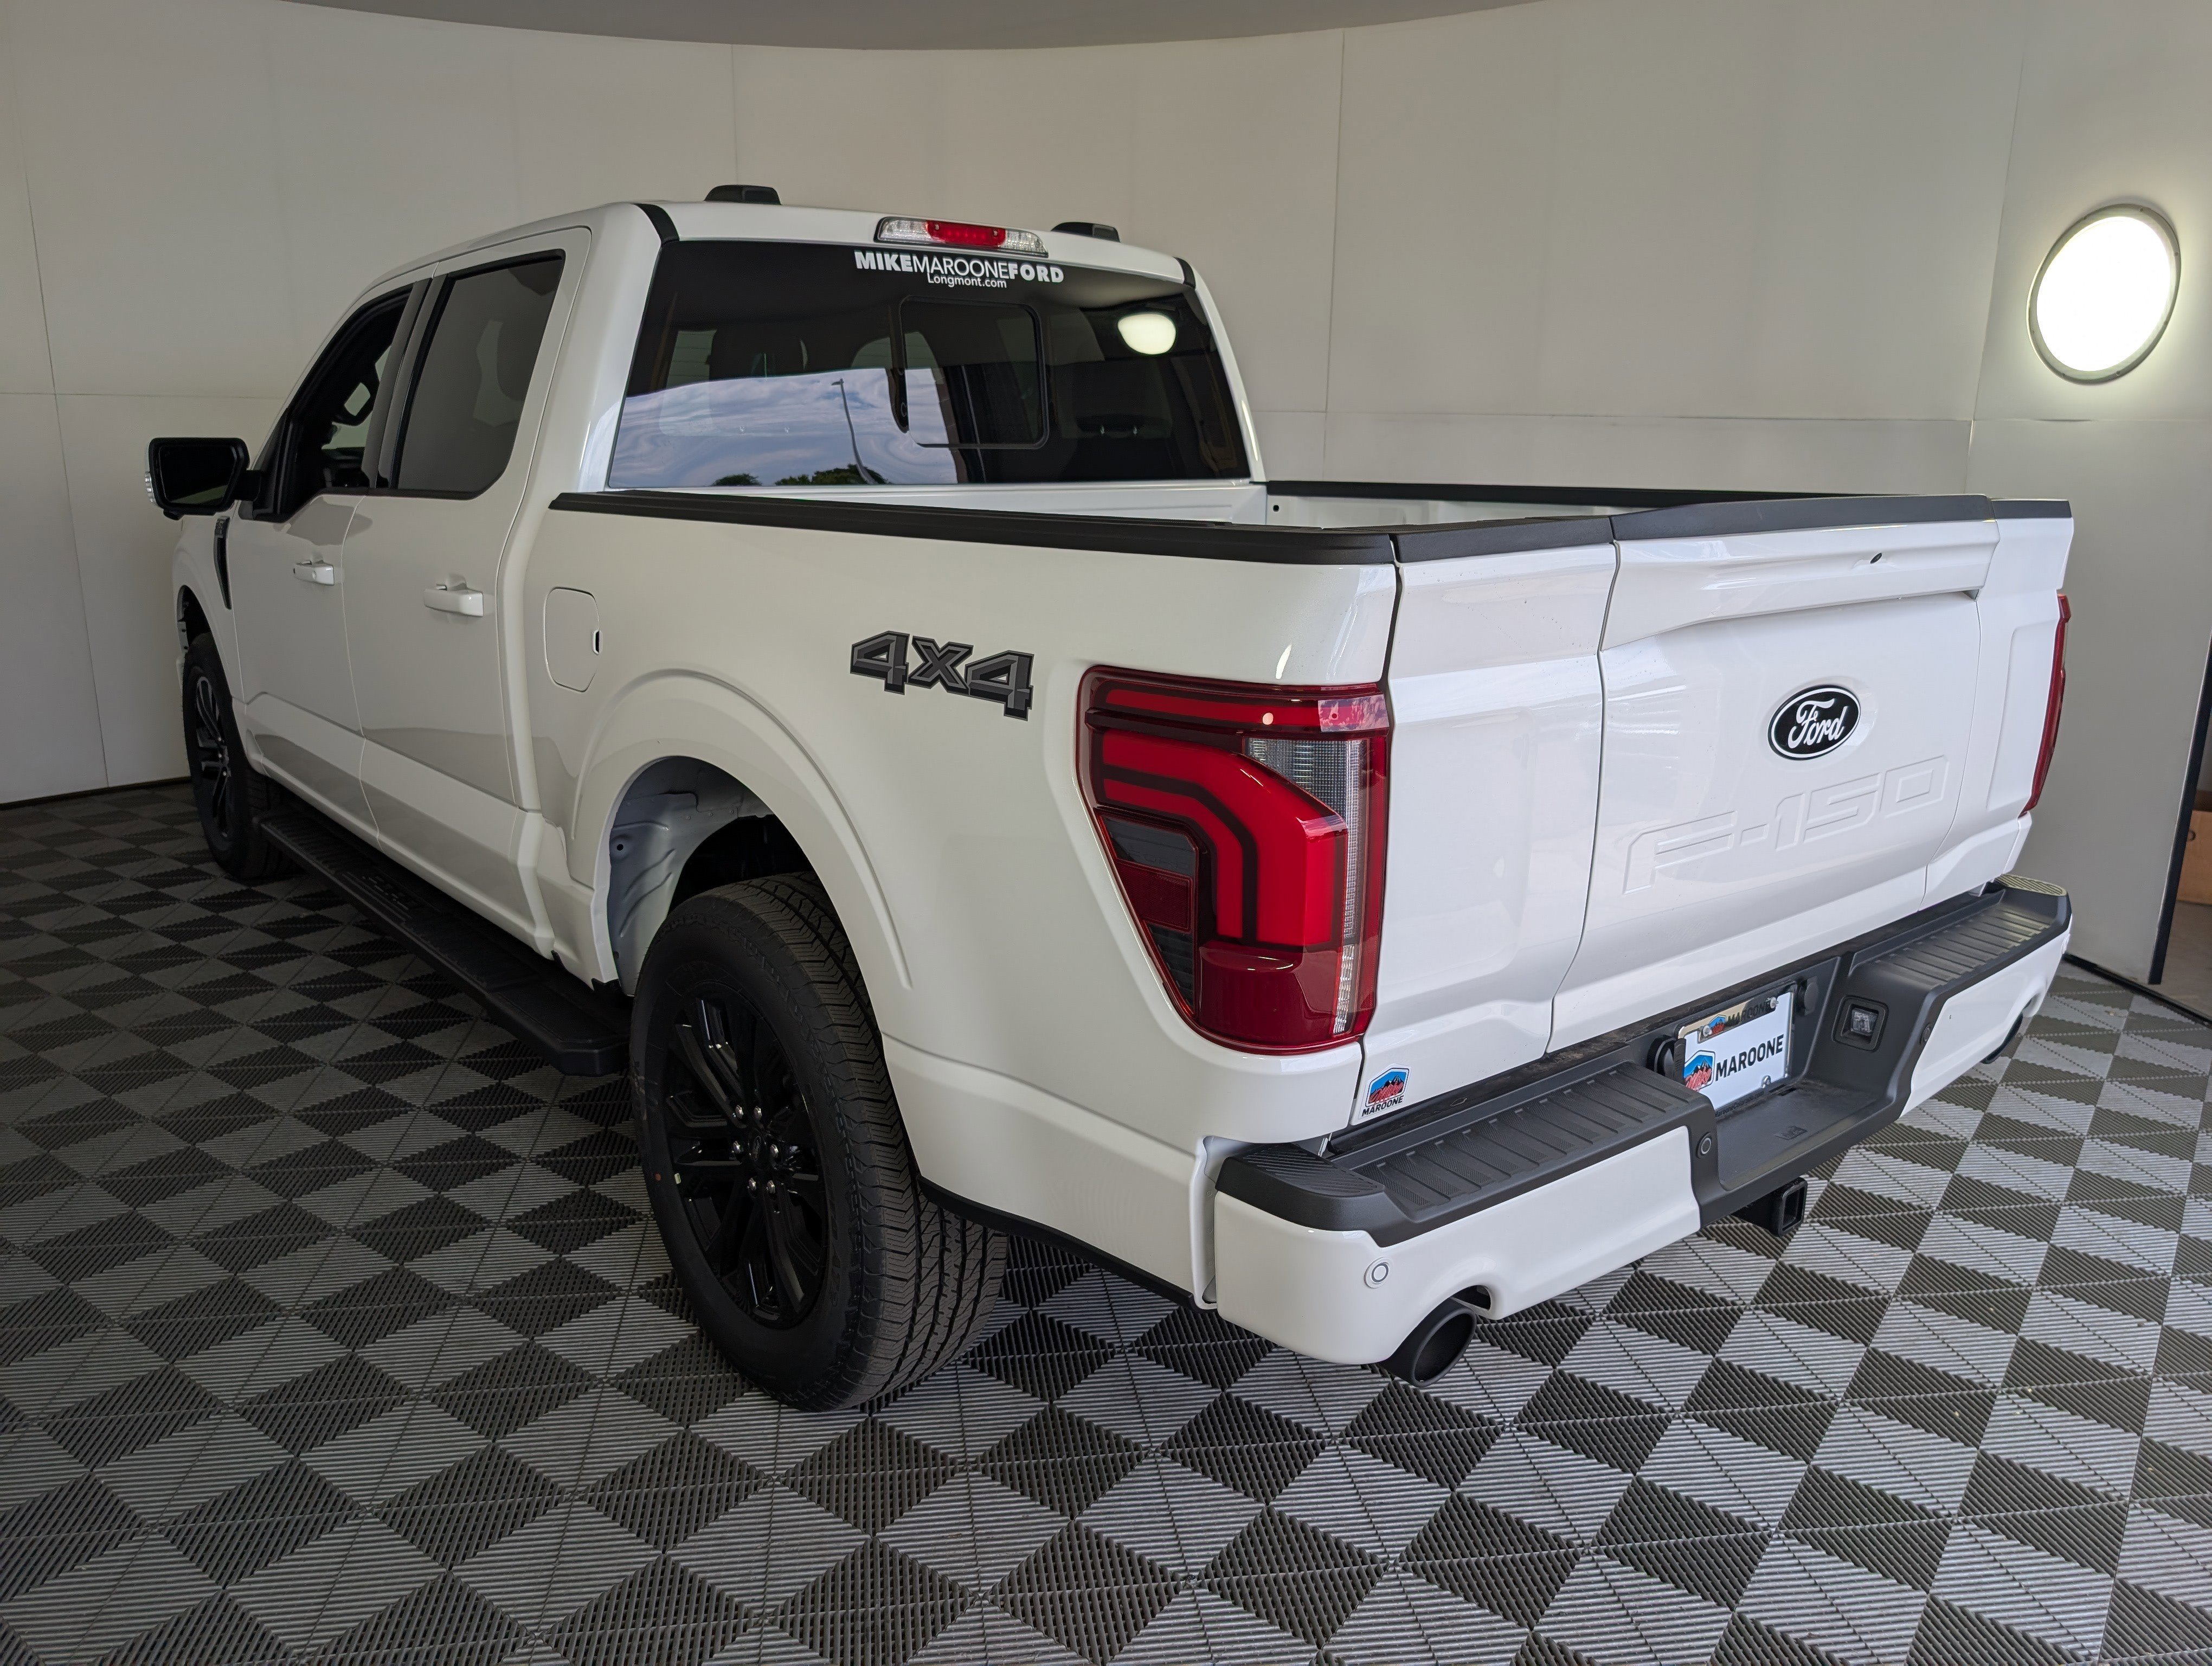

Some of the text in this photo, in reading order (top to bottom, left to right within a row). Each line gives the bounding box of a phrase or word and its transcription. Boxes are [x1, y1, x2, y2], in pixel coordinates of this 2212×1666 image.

[927, 272, 1007, 289] Longmont.com
[1787, 697, 1848, 749] Ford
[1622, 754, 1950, 895] F-150
[1715, 1034, 1784, 1082] MAROONE
[1361, 1095, 1404, 1117] MAROONE
